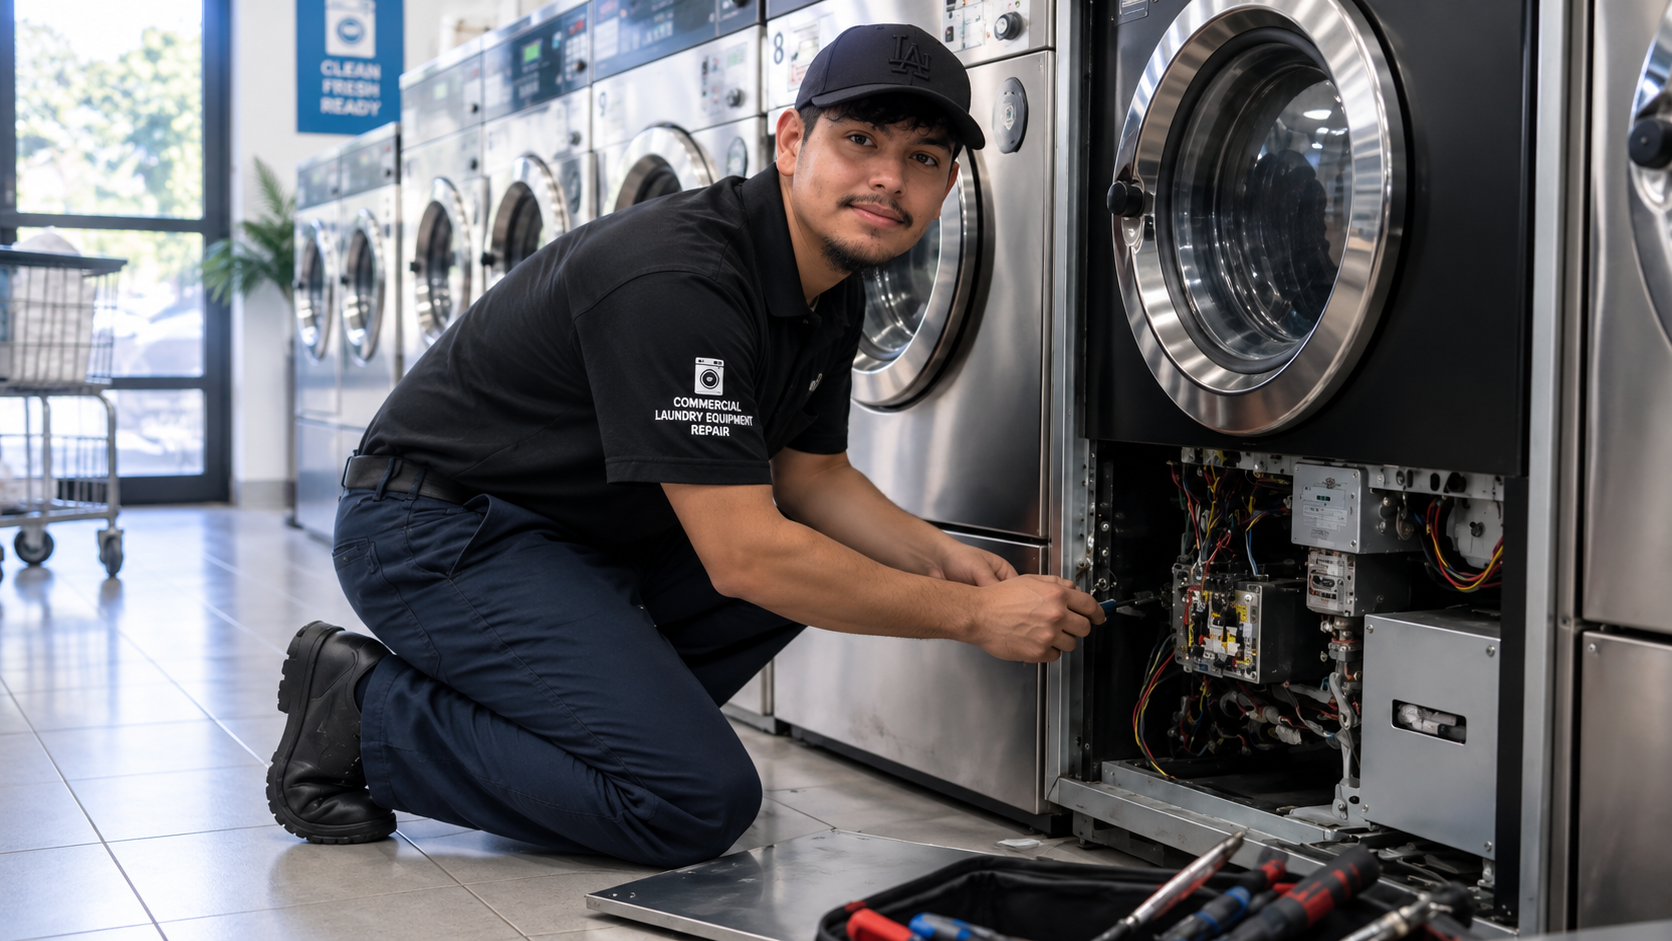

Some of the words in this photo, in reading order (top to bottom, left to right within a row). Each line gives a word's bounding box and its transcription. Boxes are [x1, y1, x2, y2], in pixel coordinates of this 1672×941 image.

[773, 31, 784, 65] 8
[888, 34, 931, 82] LA
[320, 59, 382, 81] CLEAN
[321, 77, 381, 99] FRESH
[320, 96, 382, 117] READY
[673, 396, 742, 412] COMMERCIAL
[654, 409, 704, 423] LAUNDRY
[705, 413, 754, 427] EQUIPMENT
[690, 424, 730, 437] REPAIR
